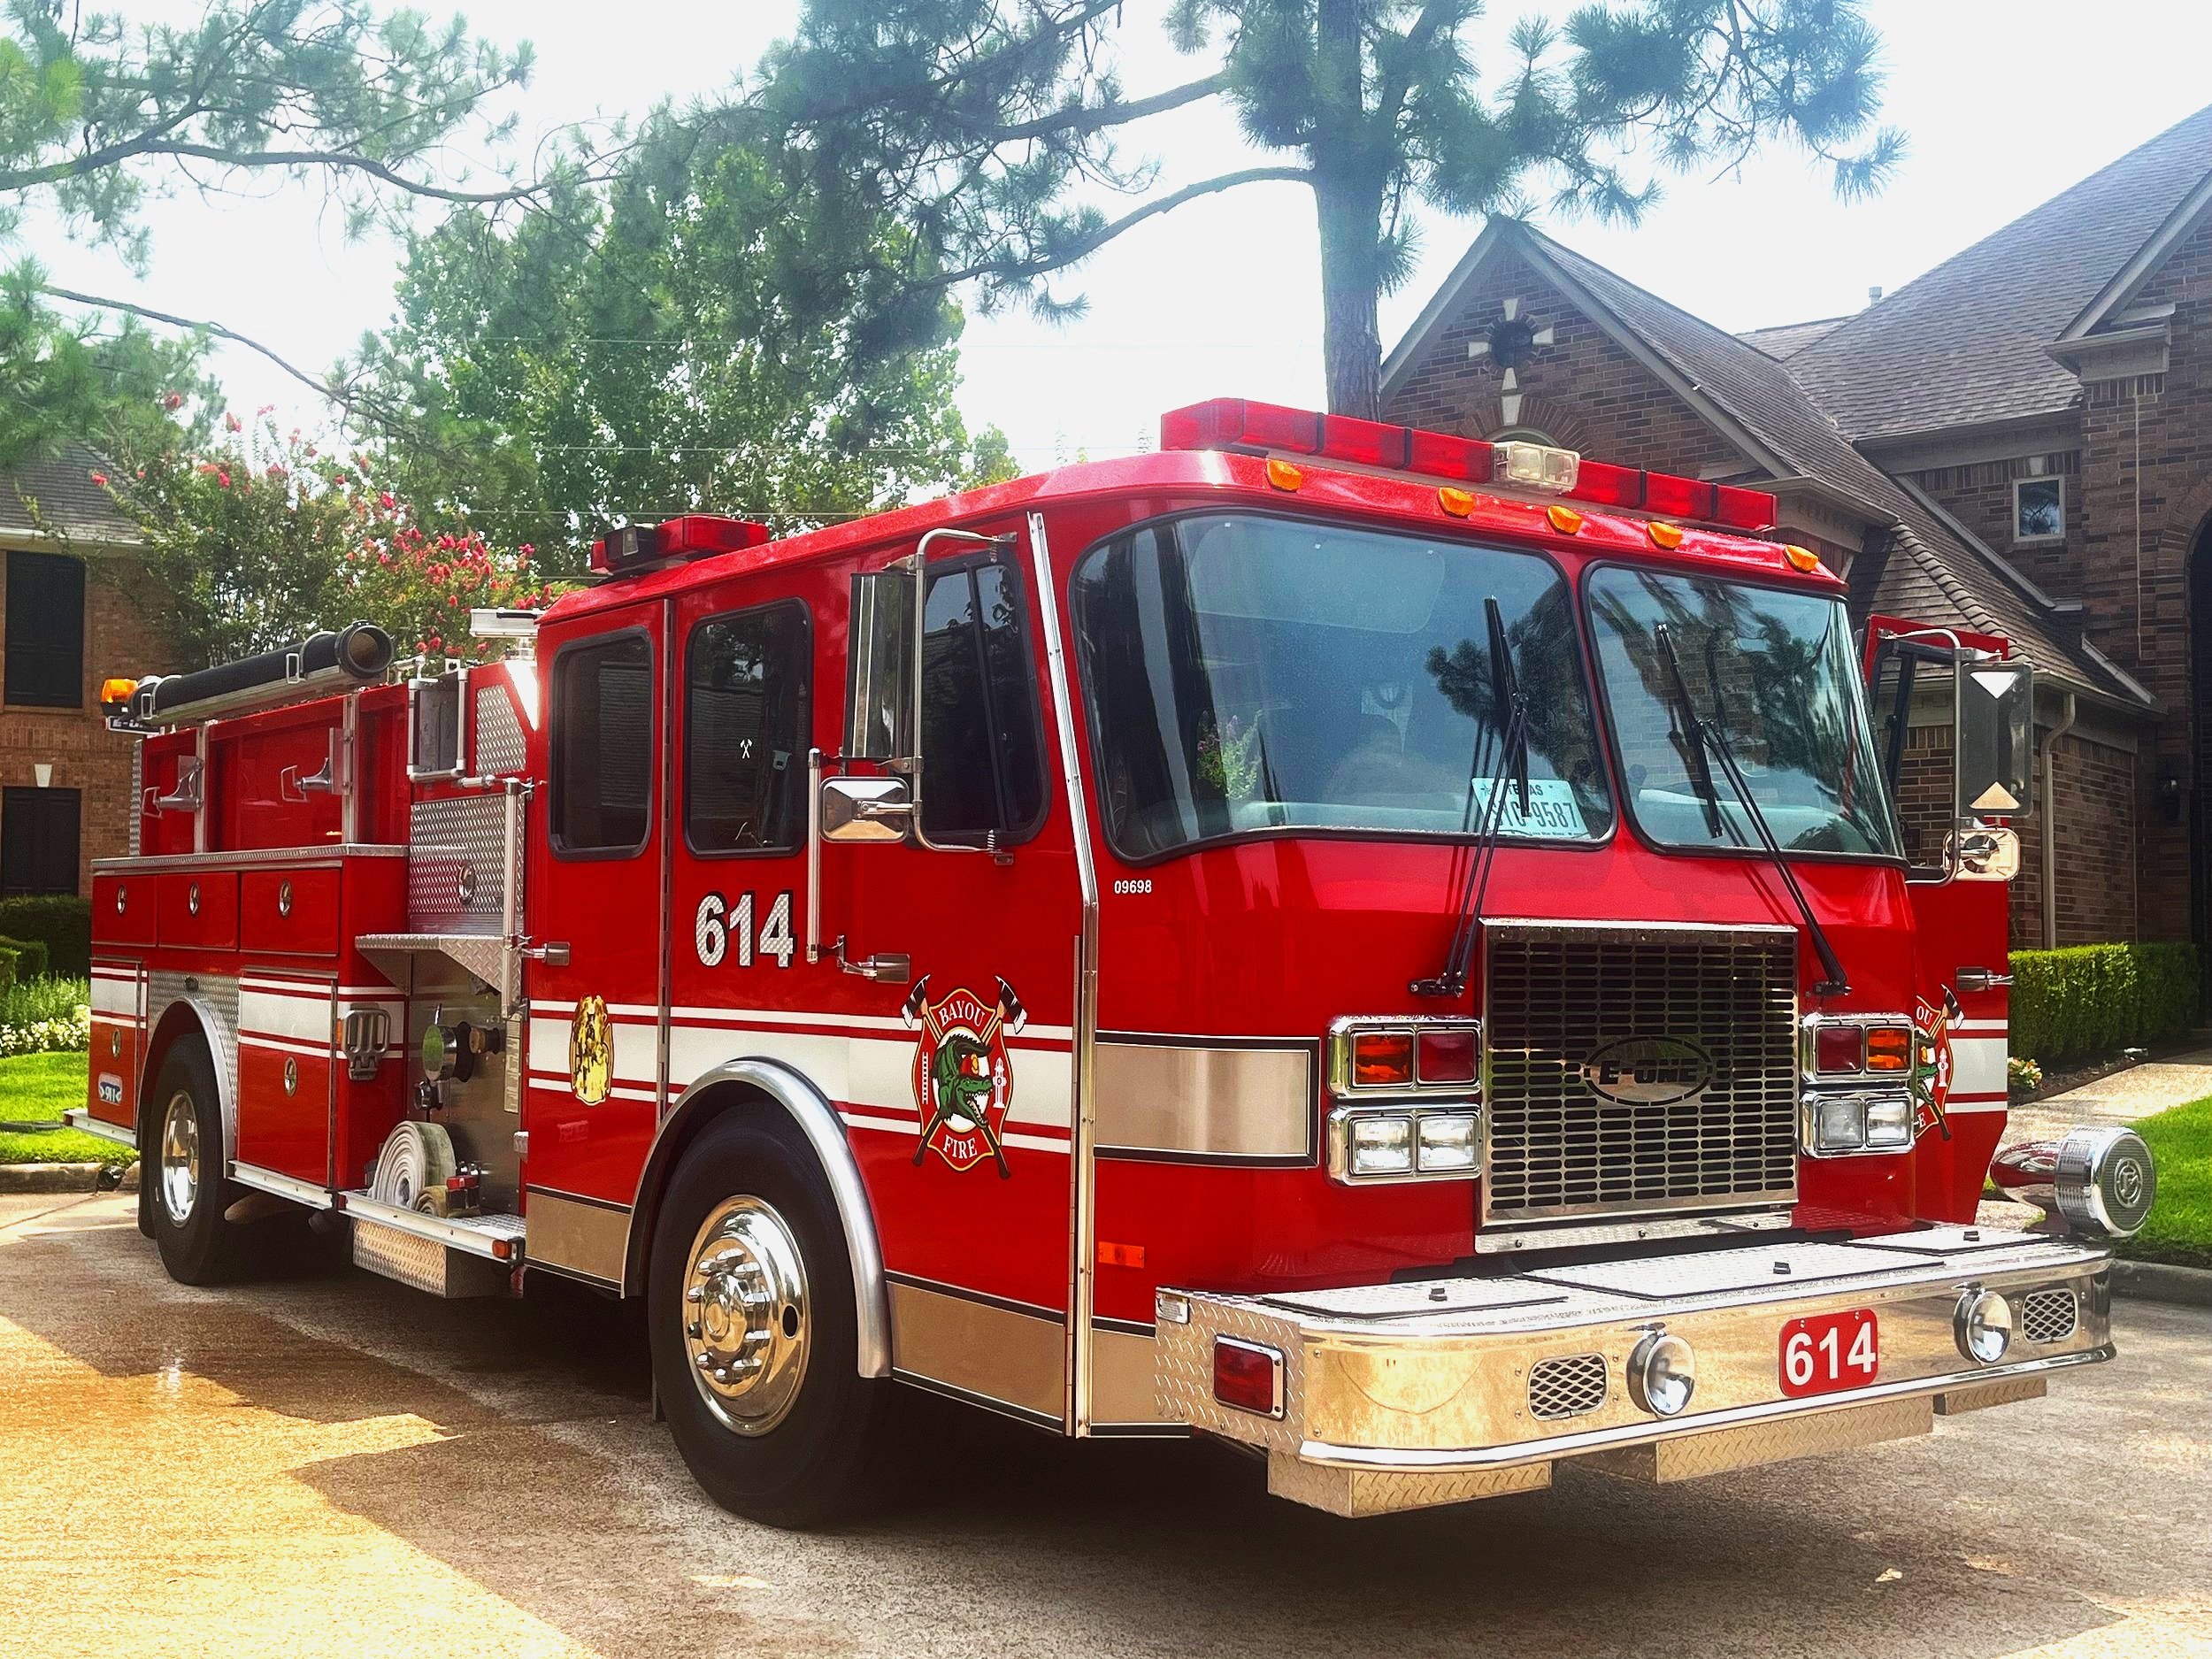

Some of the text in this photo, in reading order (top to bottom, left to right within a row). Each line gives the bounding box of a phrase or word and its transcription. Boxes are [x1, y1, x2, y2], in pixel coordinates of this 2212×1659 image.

[1507, 783, 1544, 796] TEAS
[1114, 879, 1153, 895] 09698
[695, 892, 795, 968] 614
[938, 1000, 987, 1027] BAYOU
[942, 1133, 978, 1159] FIRE
[1785, 1321, 1877, 1386] 614
